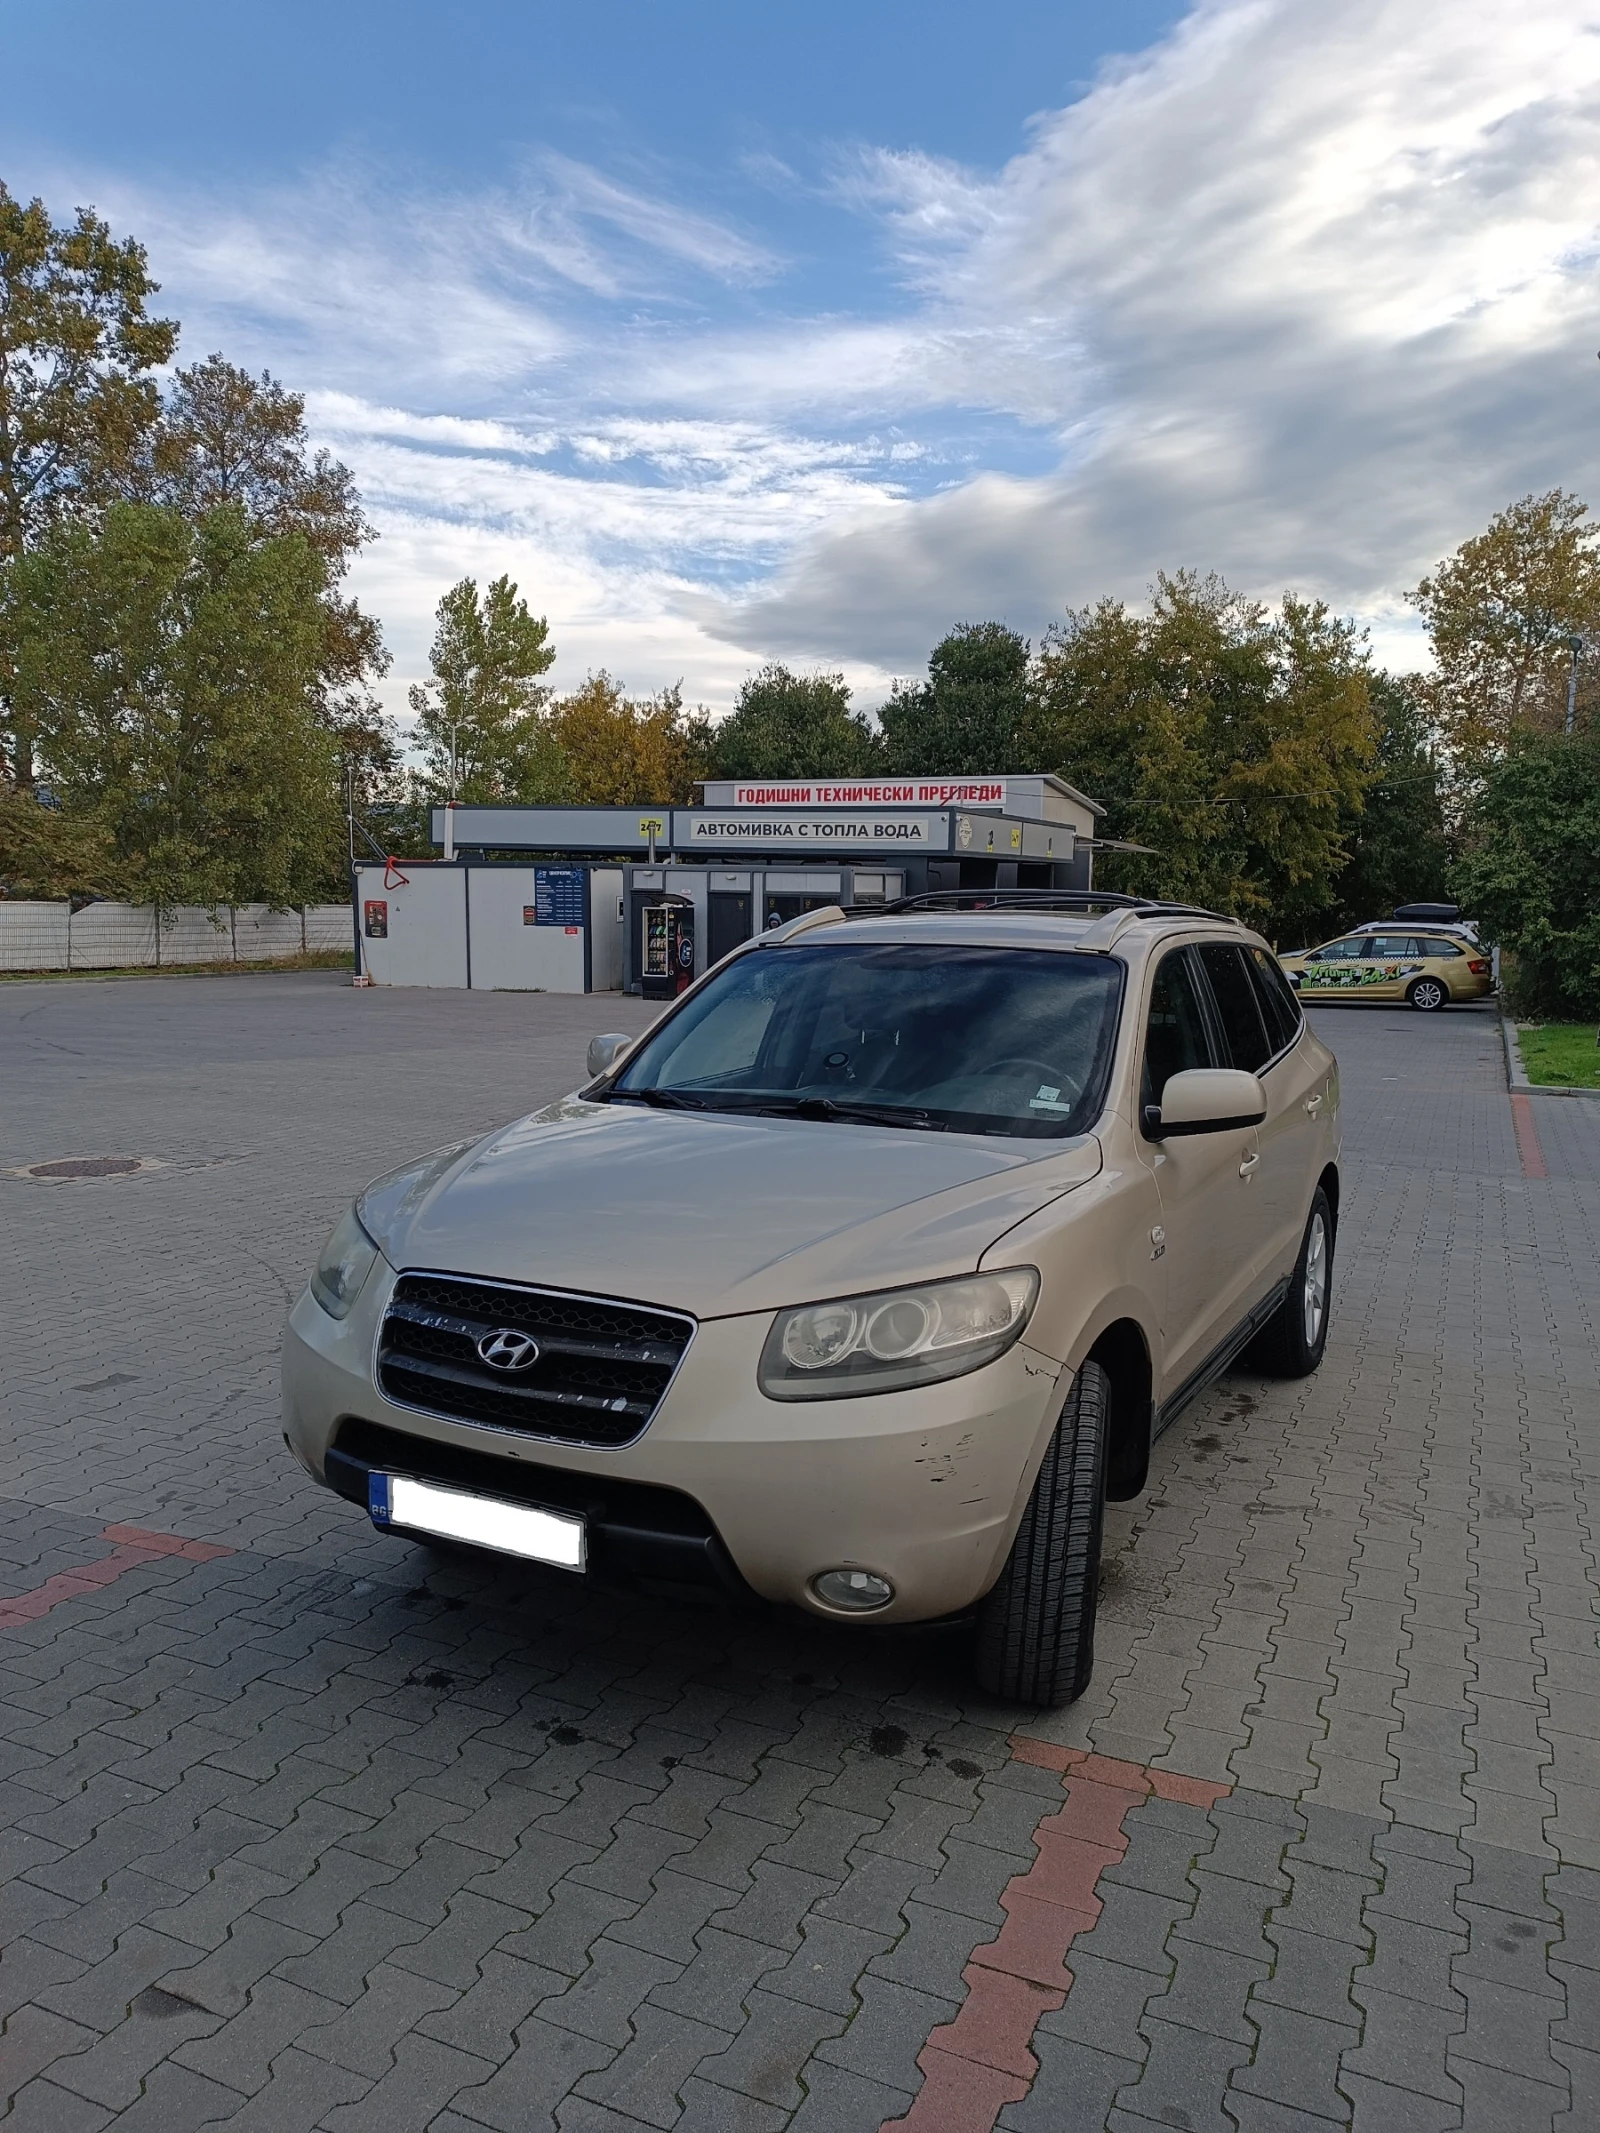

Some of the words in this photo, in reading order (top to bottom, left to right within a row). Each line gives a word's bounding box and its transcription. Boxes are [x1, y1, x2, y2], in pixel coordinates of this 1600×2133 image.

[738, 788, 811, 804] ГОДИШНИ
[816, 786, 913, 802] ТЕХНИЧЕСКИ
[919, 785, 1002, 801] ПРЕГЛЕДИ
[697, 823, 794, 837] АВТОМИВКА
[798, 824, 808, 837] С
[813, 824, 869, 837] ТОПЛА
[874, 824, 922, 839] ВОДА
[371, 1504, 387, 1517] BG
